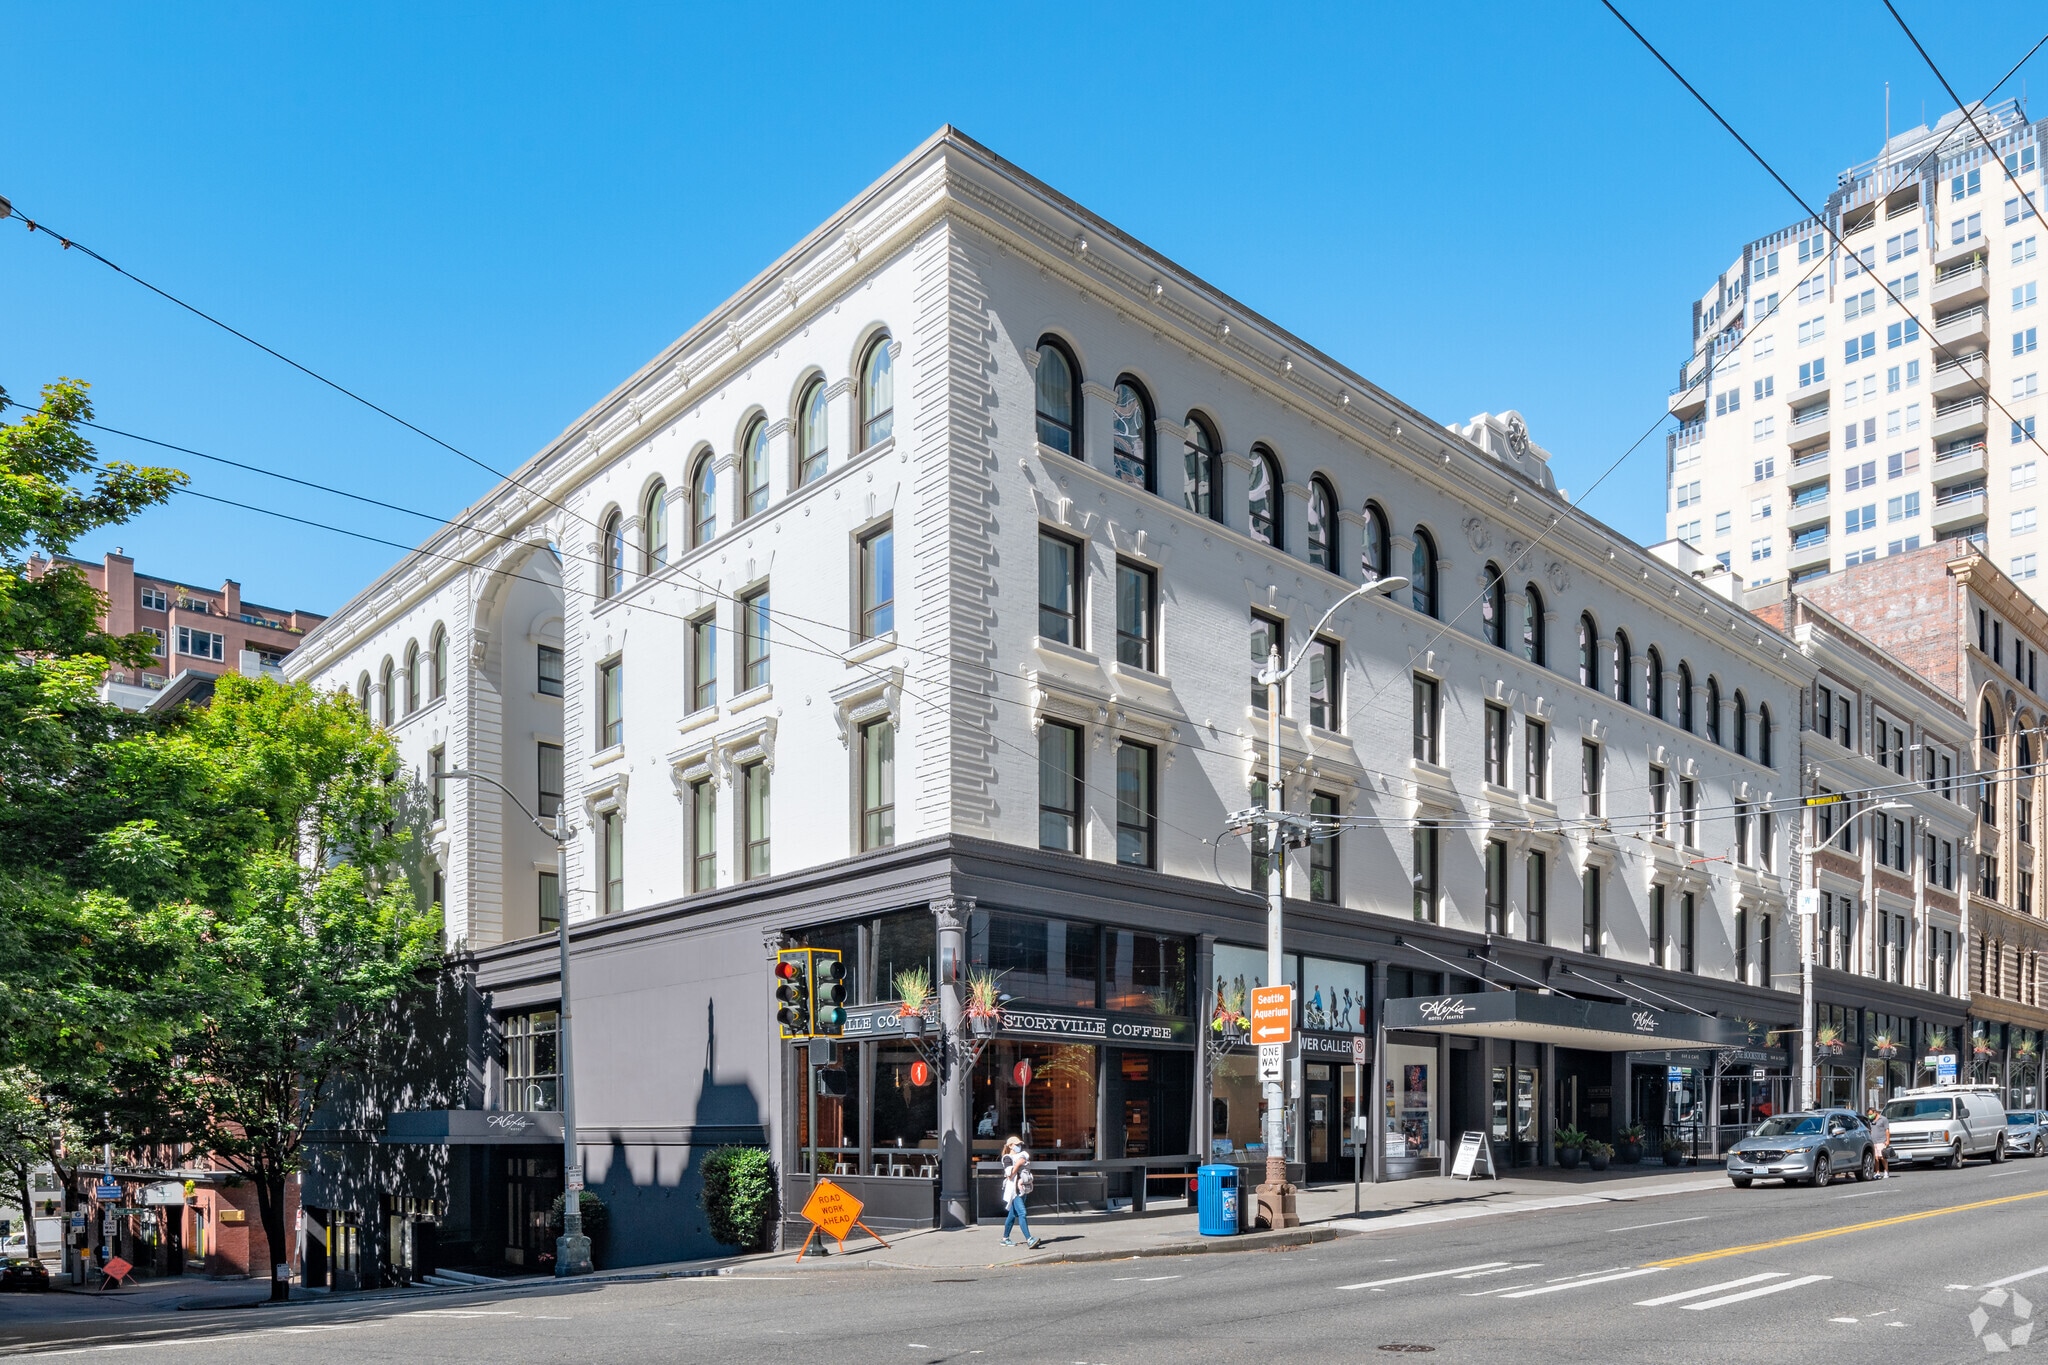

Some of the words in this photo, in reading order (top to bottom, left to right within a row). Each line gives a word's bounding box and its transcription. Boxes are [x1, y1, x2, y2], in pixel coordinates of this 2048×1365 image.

[1257, 994, 1284, 1005] Seattle
[1254, 1008, 1288, 1020] Aquarium
[1420, 998, 1476, 1021] Alexis
[1003, 1014, 1106, 1034] STORYVILLE
[1112, 1023, 1172, 1039] COFFEE
[1262, 1047, 1280, 1056] ONE
[1262, 1057, 1280, 1067] WAY
[486, 1113, 535, 1129] Alexis
[818, 1193, 841, 1204] ROAD
[821, 1204, 845, 1214] WORK
[823, 1214, 850, 1226] AHEAD
